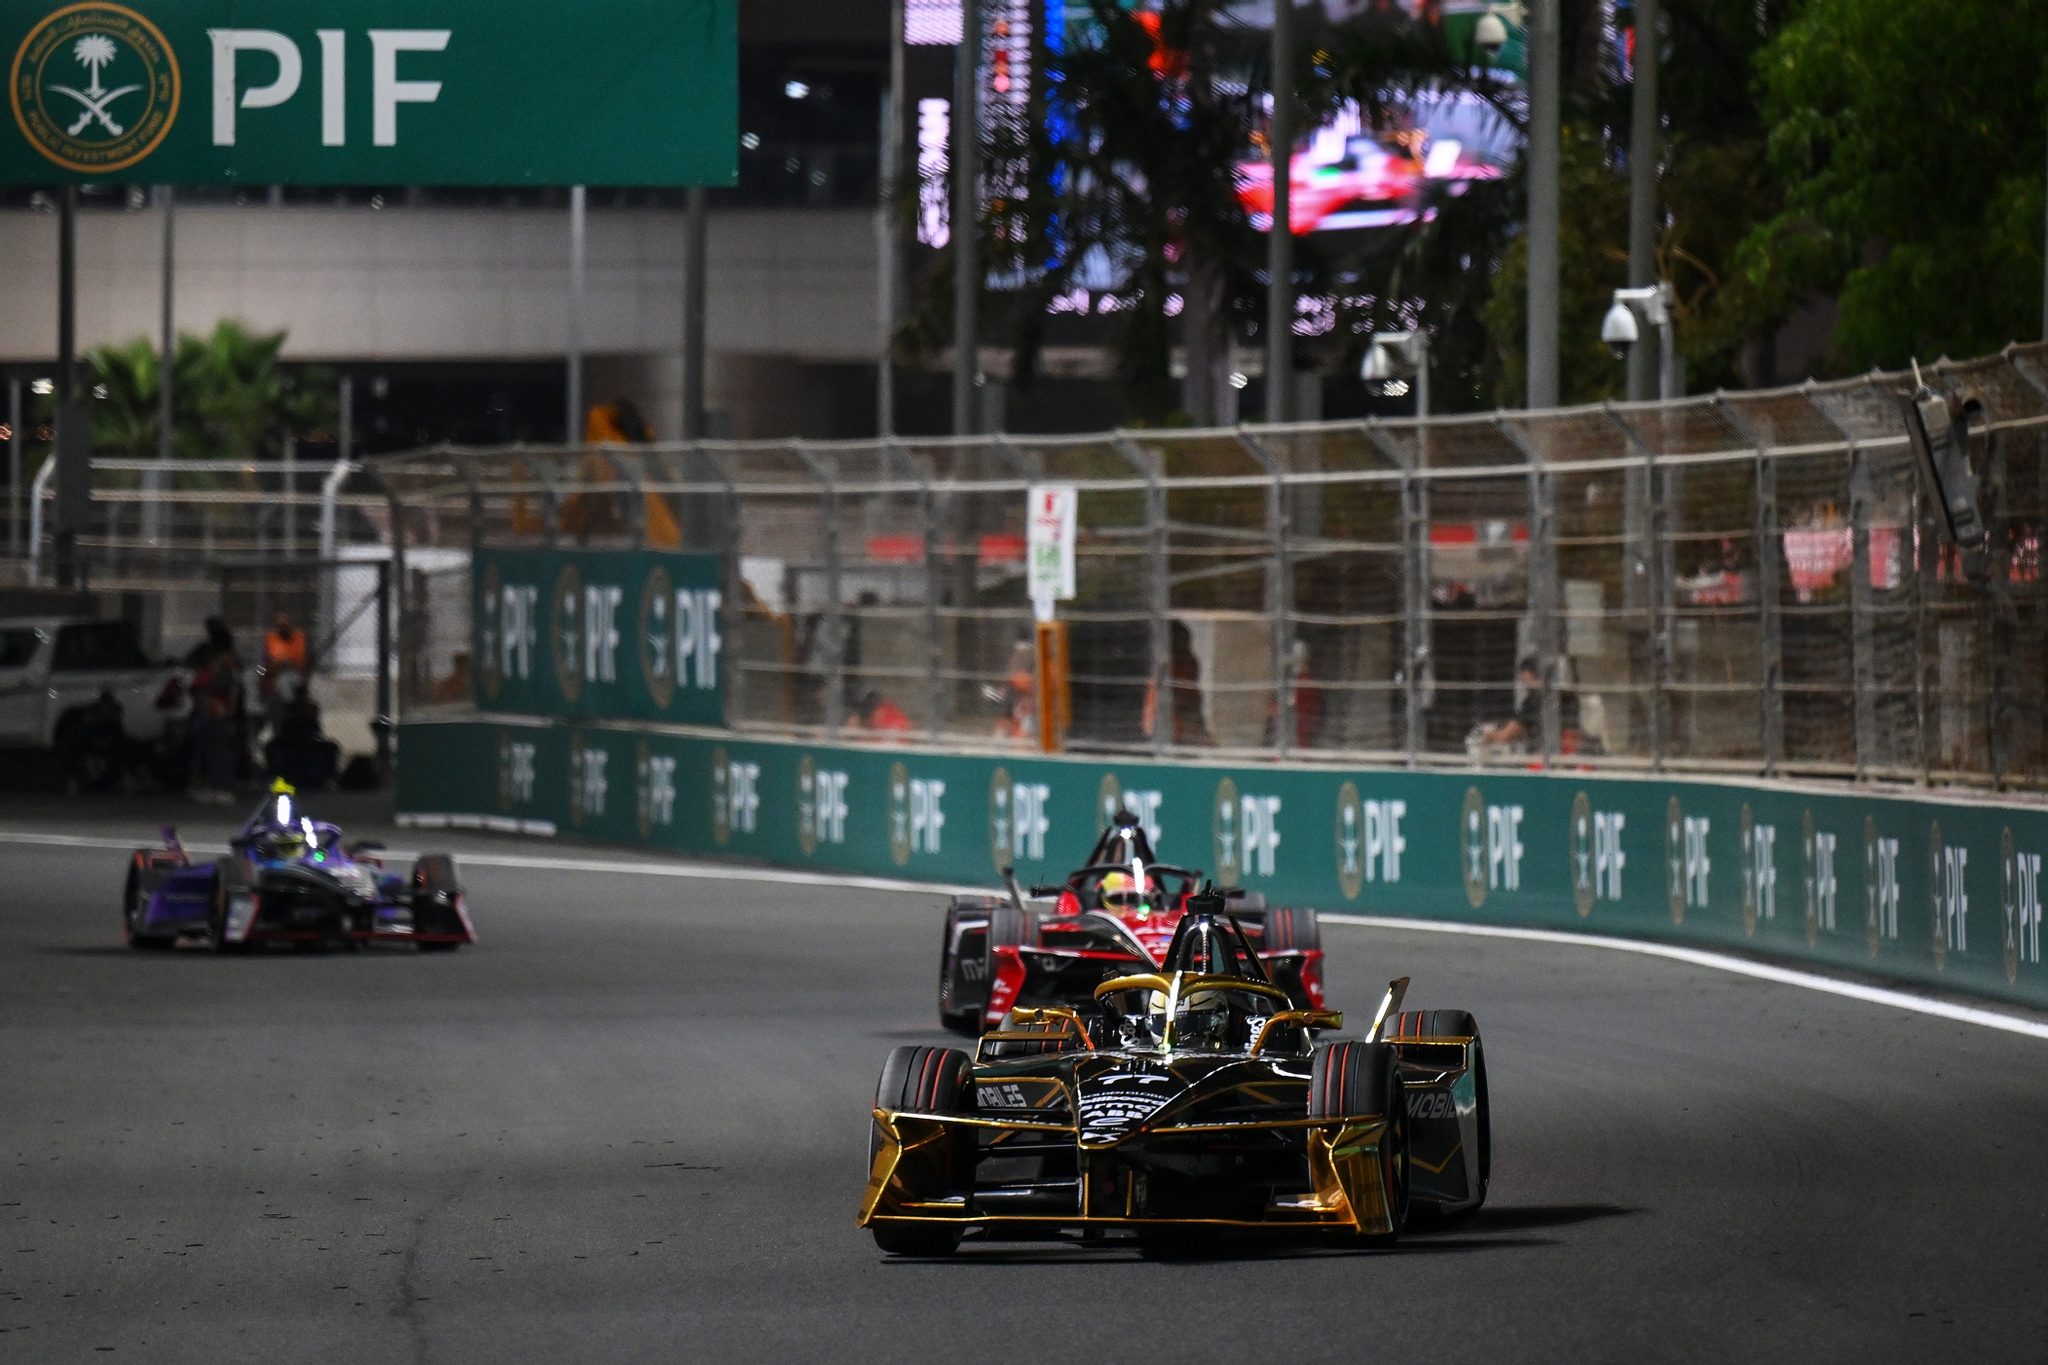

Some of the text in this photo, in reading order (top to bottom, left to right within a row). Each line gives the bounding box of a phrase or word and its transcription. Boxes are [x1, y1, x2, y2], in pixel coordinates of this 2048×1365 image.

[207, 29, 452, 146] PIF
[677, 590, 722, 688] PIF
[909, 780, 945, 852] PIF
[1012, 784, 1049, 858] PIF
[1241, 796, 1280, 874] PIF
[1364, 800, 1405, 880] PIF
[1487, 806, 1523, 888] PIF
[1594, 812, 1625, 898] PIF
[1684, 817, 1710, 905] PIF
[1754, 826, 1776, 917] PIF
[1815, 833, 1836, 928] PIF
[1878, 839, 1899, 937] PIF
[1945, 847, 1968, 950] PIF
[2018, 853, 2041, 962] PIF
